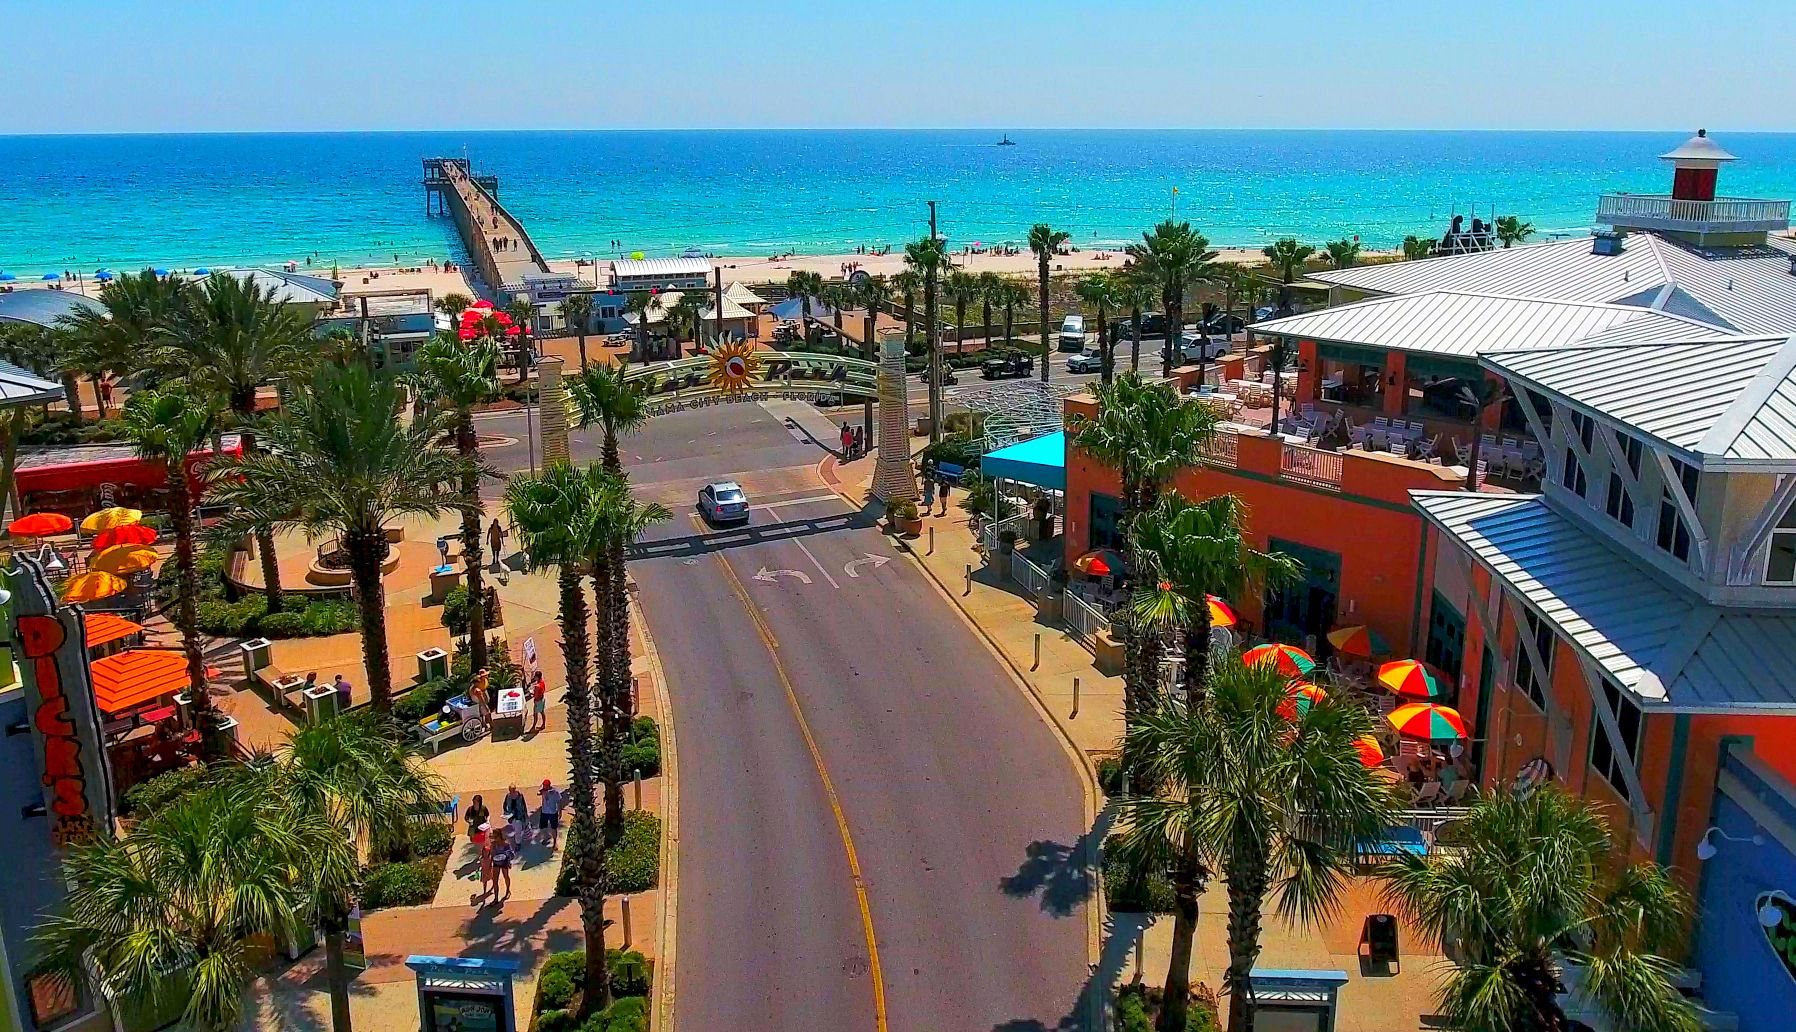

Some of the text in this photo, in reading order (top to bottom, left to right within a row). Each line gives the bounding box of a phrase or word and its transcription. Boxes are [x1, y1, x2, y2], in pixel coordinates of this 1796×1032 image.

[689, 395, 720, 410] CITY
[726, 391, 769, 404] BEACH
[783, 391, 836, 402] FLORIDA
